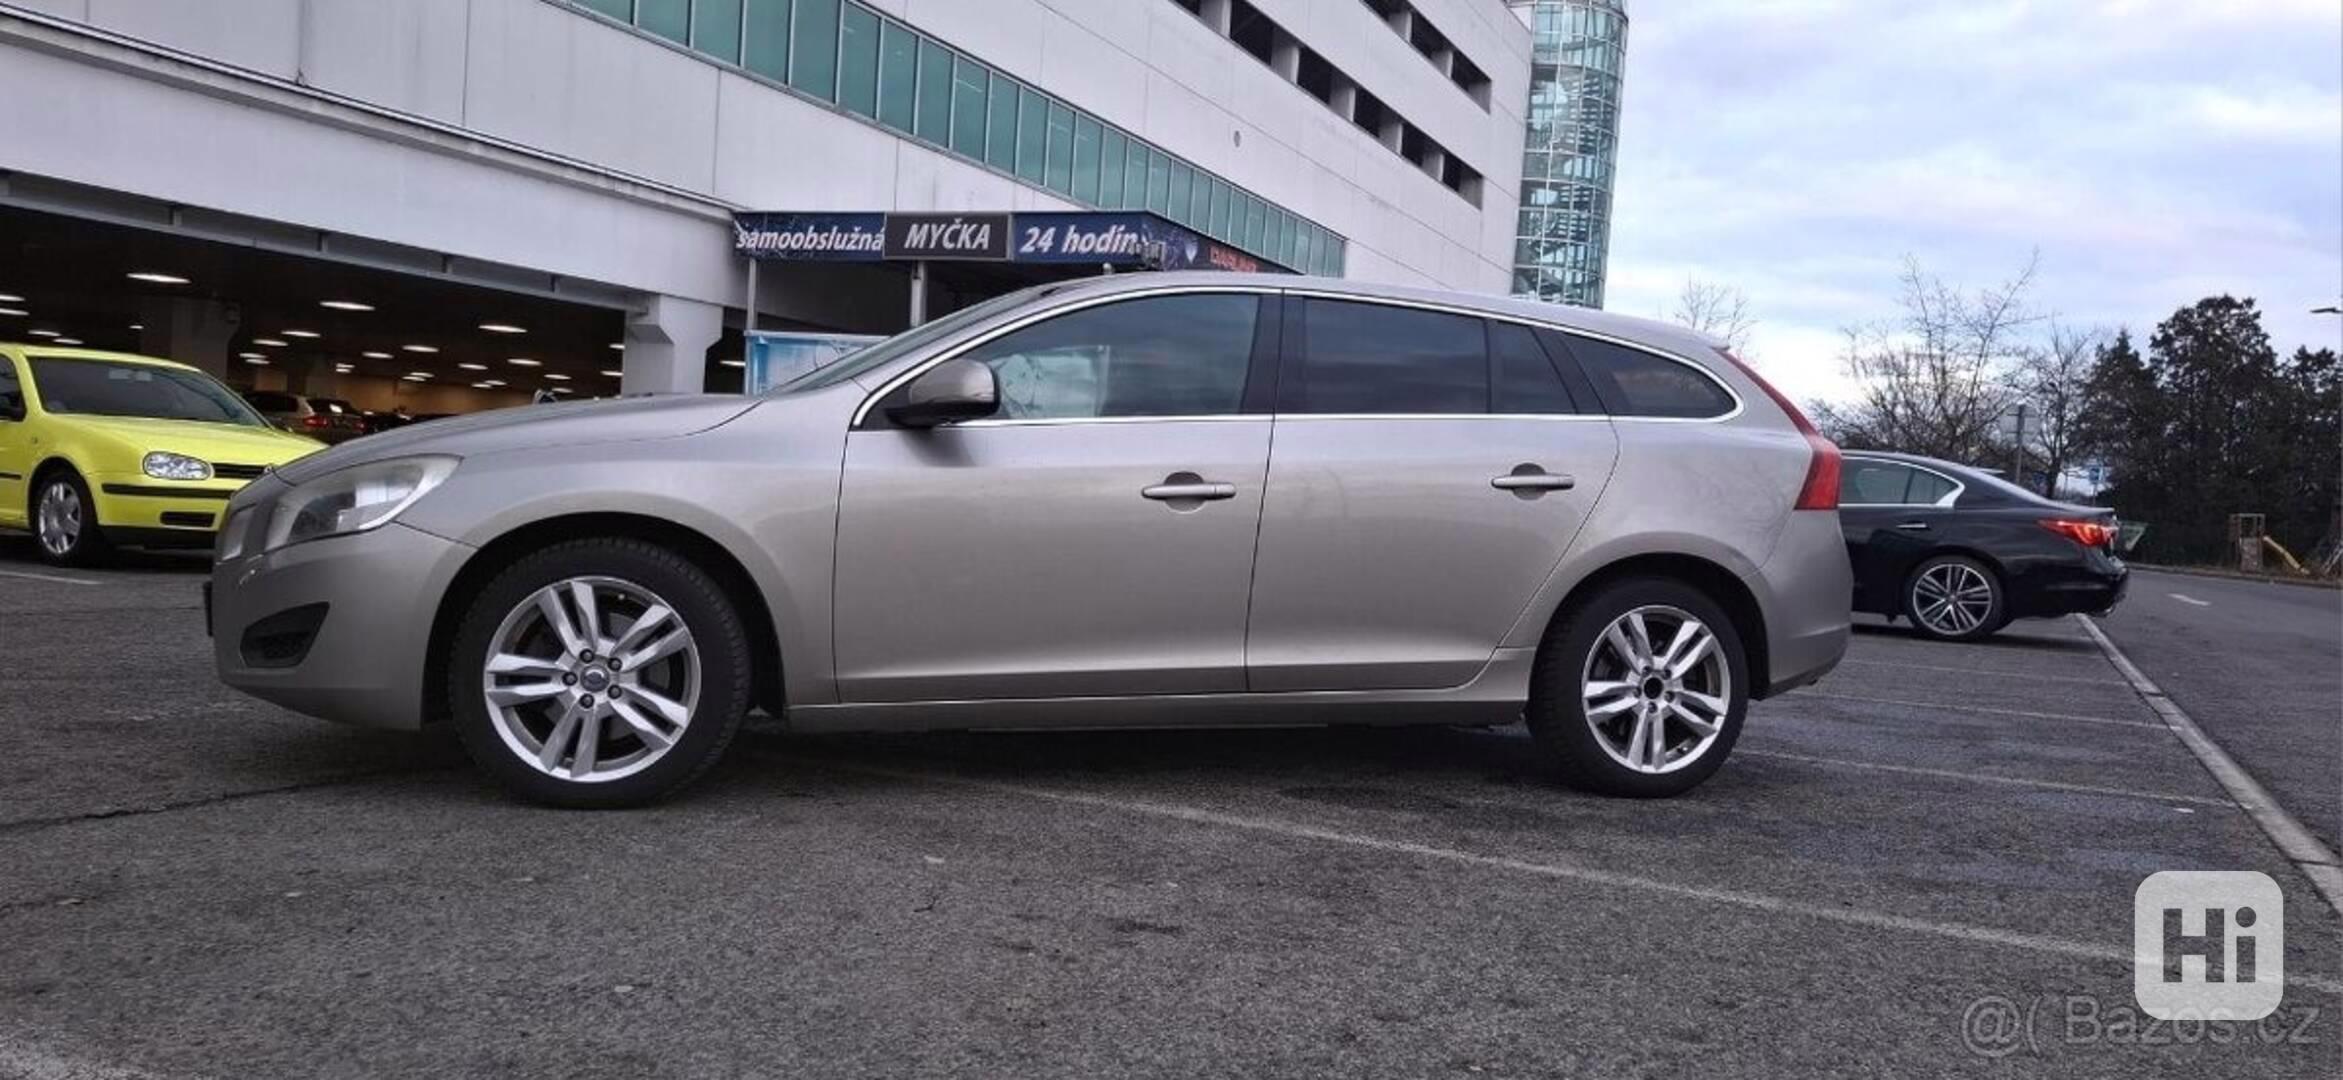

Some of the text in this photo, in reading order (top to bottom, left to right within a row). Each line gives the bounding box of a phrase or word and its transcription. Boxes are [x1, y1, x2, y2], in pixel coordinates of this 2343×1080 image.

[735, 224, 887, 250] samoobslužná
[903, 218, 992, 250] MYČKA
[1019, 226, 1056, 253] 24
